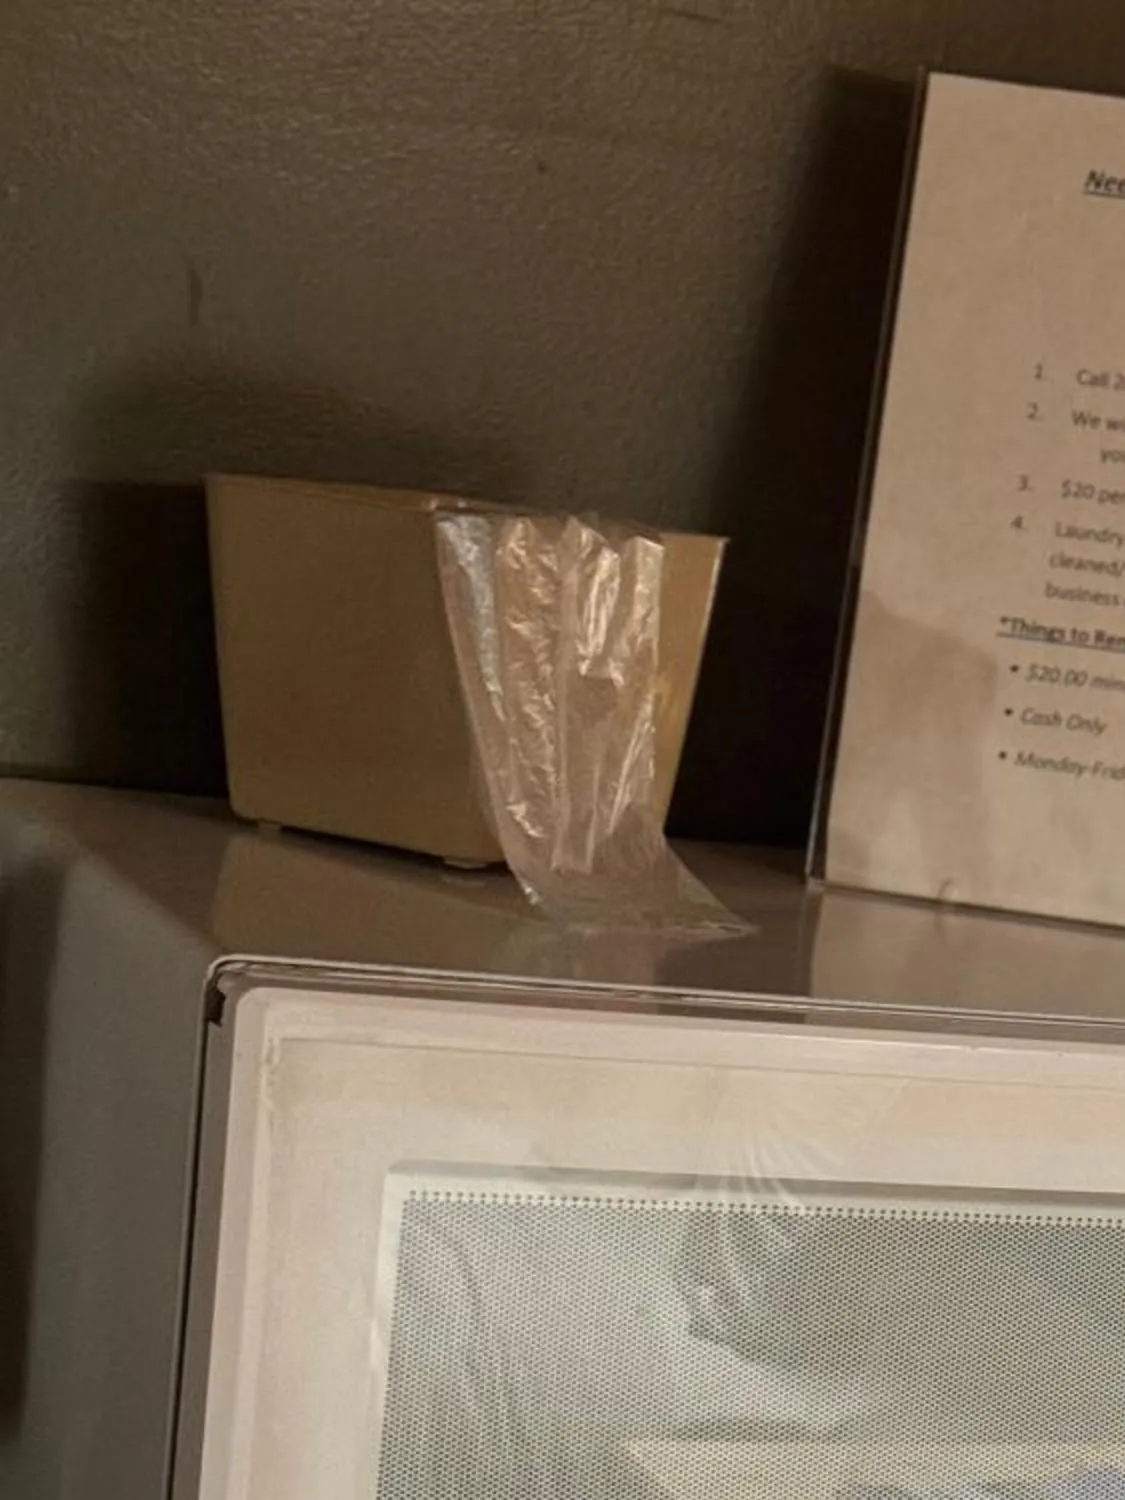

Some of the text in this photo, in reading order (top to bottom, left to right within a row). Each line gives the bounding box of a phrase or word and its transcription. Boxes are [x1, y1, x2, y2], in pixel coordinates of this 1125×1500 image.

[1076, 368, 1110, 389] Call
[1072, 409, 1102, 430] We
[1055, 520, 1125, 550] Laundry
[1045, 581, 1121, 611] business
[1070, 630, 1090, 646] to
[1020, 706, 1108, 737] Cash Only
